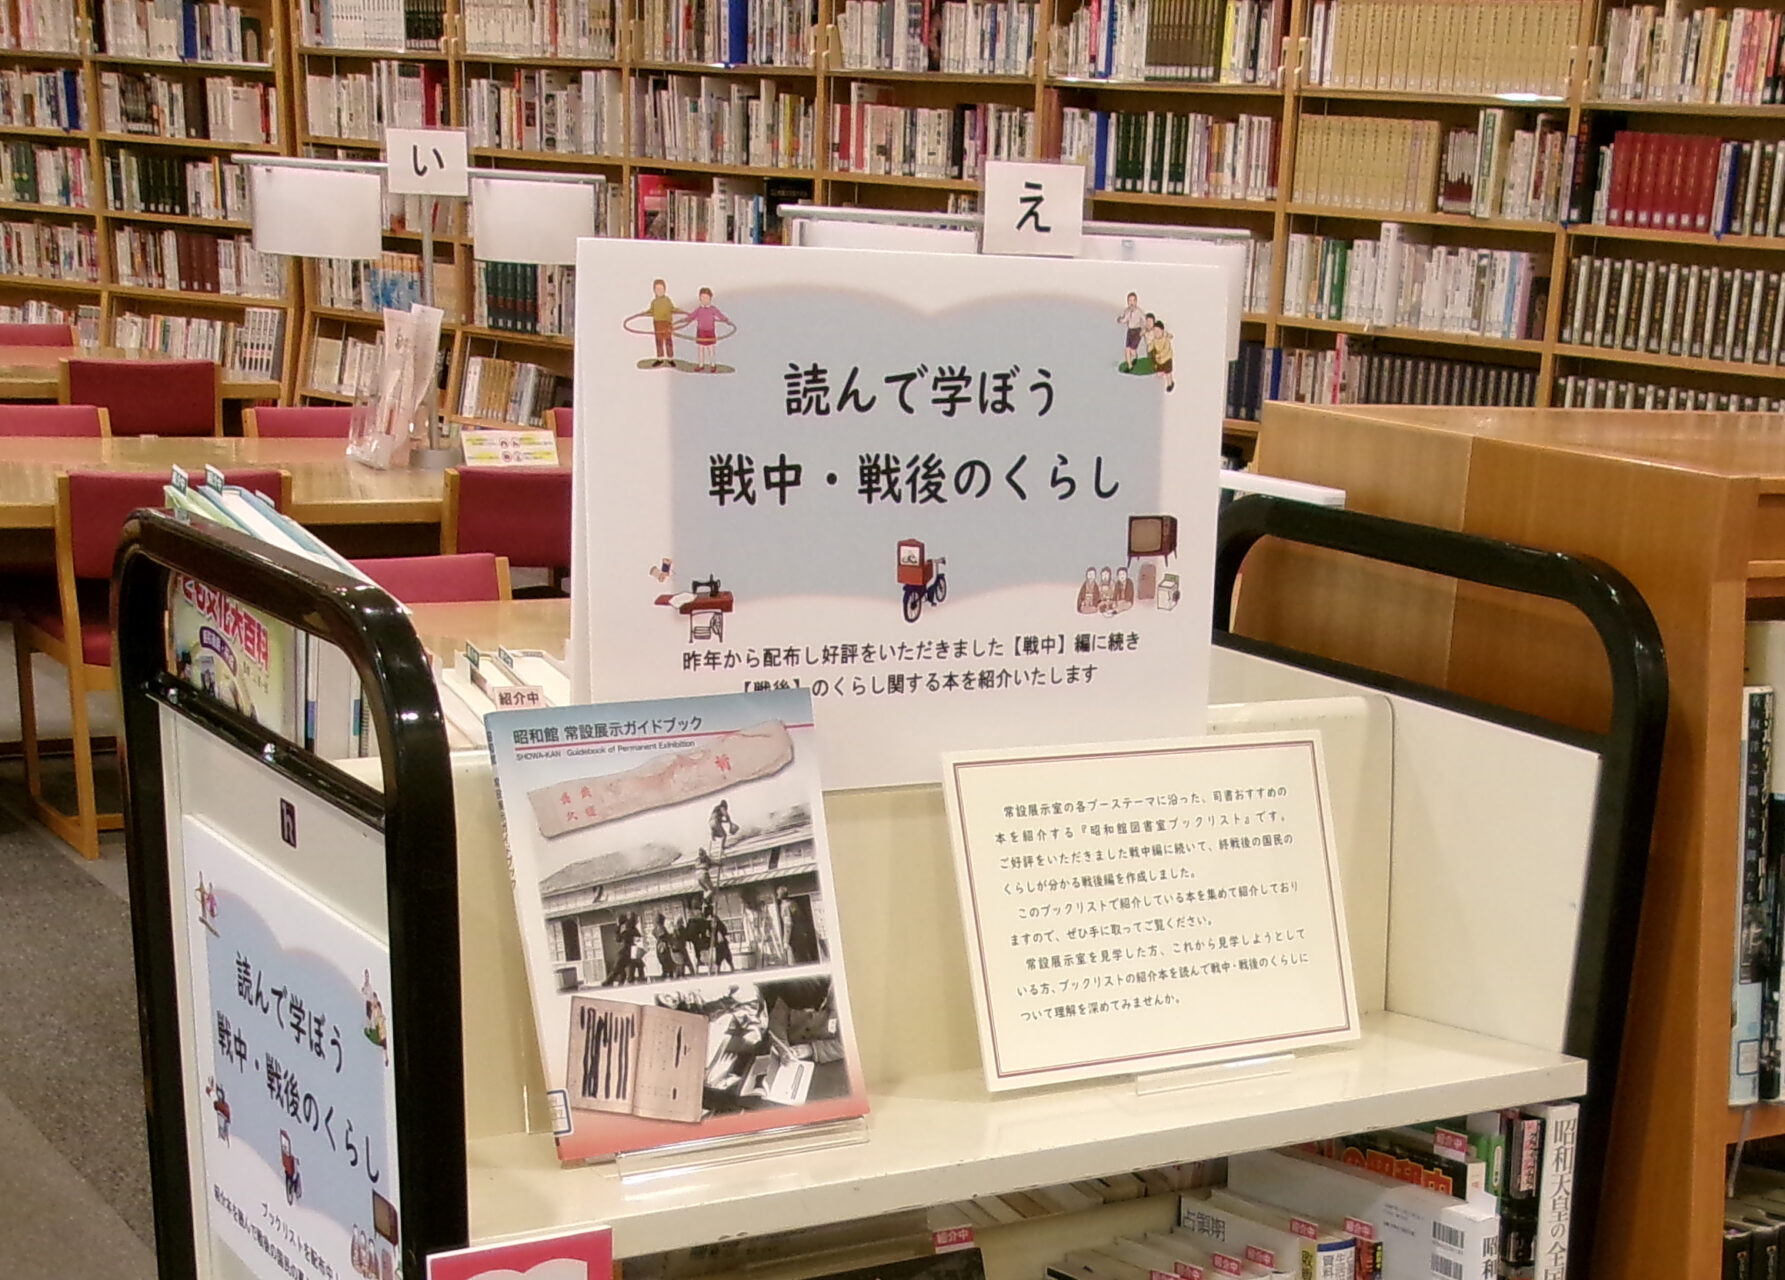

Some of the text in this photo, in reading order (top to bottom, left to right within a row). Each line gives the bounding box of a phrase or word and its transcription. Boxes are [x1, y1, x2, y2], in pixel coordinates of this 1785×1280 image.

[411, 143, 446, 178] い
[1015, 181, 1052, 234] え
[784, 362, 1057, 418] 読んで学ぼう
[708, 452, 1122, 506] 戦中・戦後のくらし
[681, 631, 1142, 673] 昨年から配布し好評をいただきました【戦中】編に続き
[498, 691, 540, 706] 紹介中
[513, 716, 703, 744] 昭和館 常設展示ガイドブック
[516, 750, 562, 762] SHOWA-KAN
[566, 745, 606, 757] Guidebook
[607, 744, 617, 753] of
[617, 742, 658, 754] Permanent
[1003, 867, 1196, 896] くらしが分かる戦後編を作成しました。
[1018, 881, 1299, 920] このブックリストで紹介している本を集めて紹介しており
[1010, 915, 1213, 947] ますので、ぜひ手に取ってご覧ください。
[1025, 928, 1306, 971] 常設展示室を見学した方、これから見学しようとして
[235, 950, 344, 1075] 読んで学ぼう
[1020, 993, 1181, 1022] ついて理解を深めてみませんか。
[216, 1010, 380, 1186] 戦中・戦後のくらし
